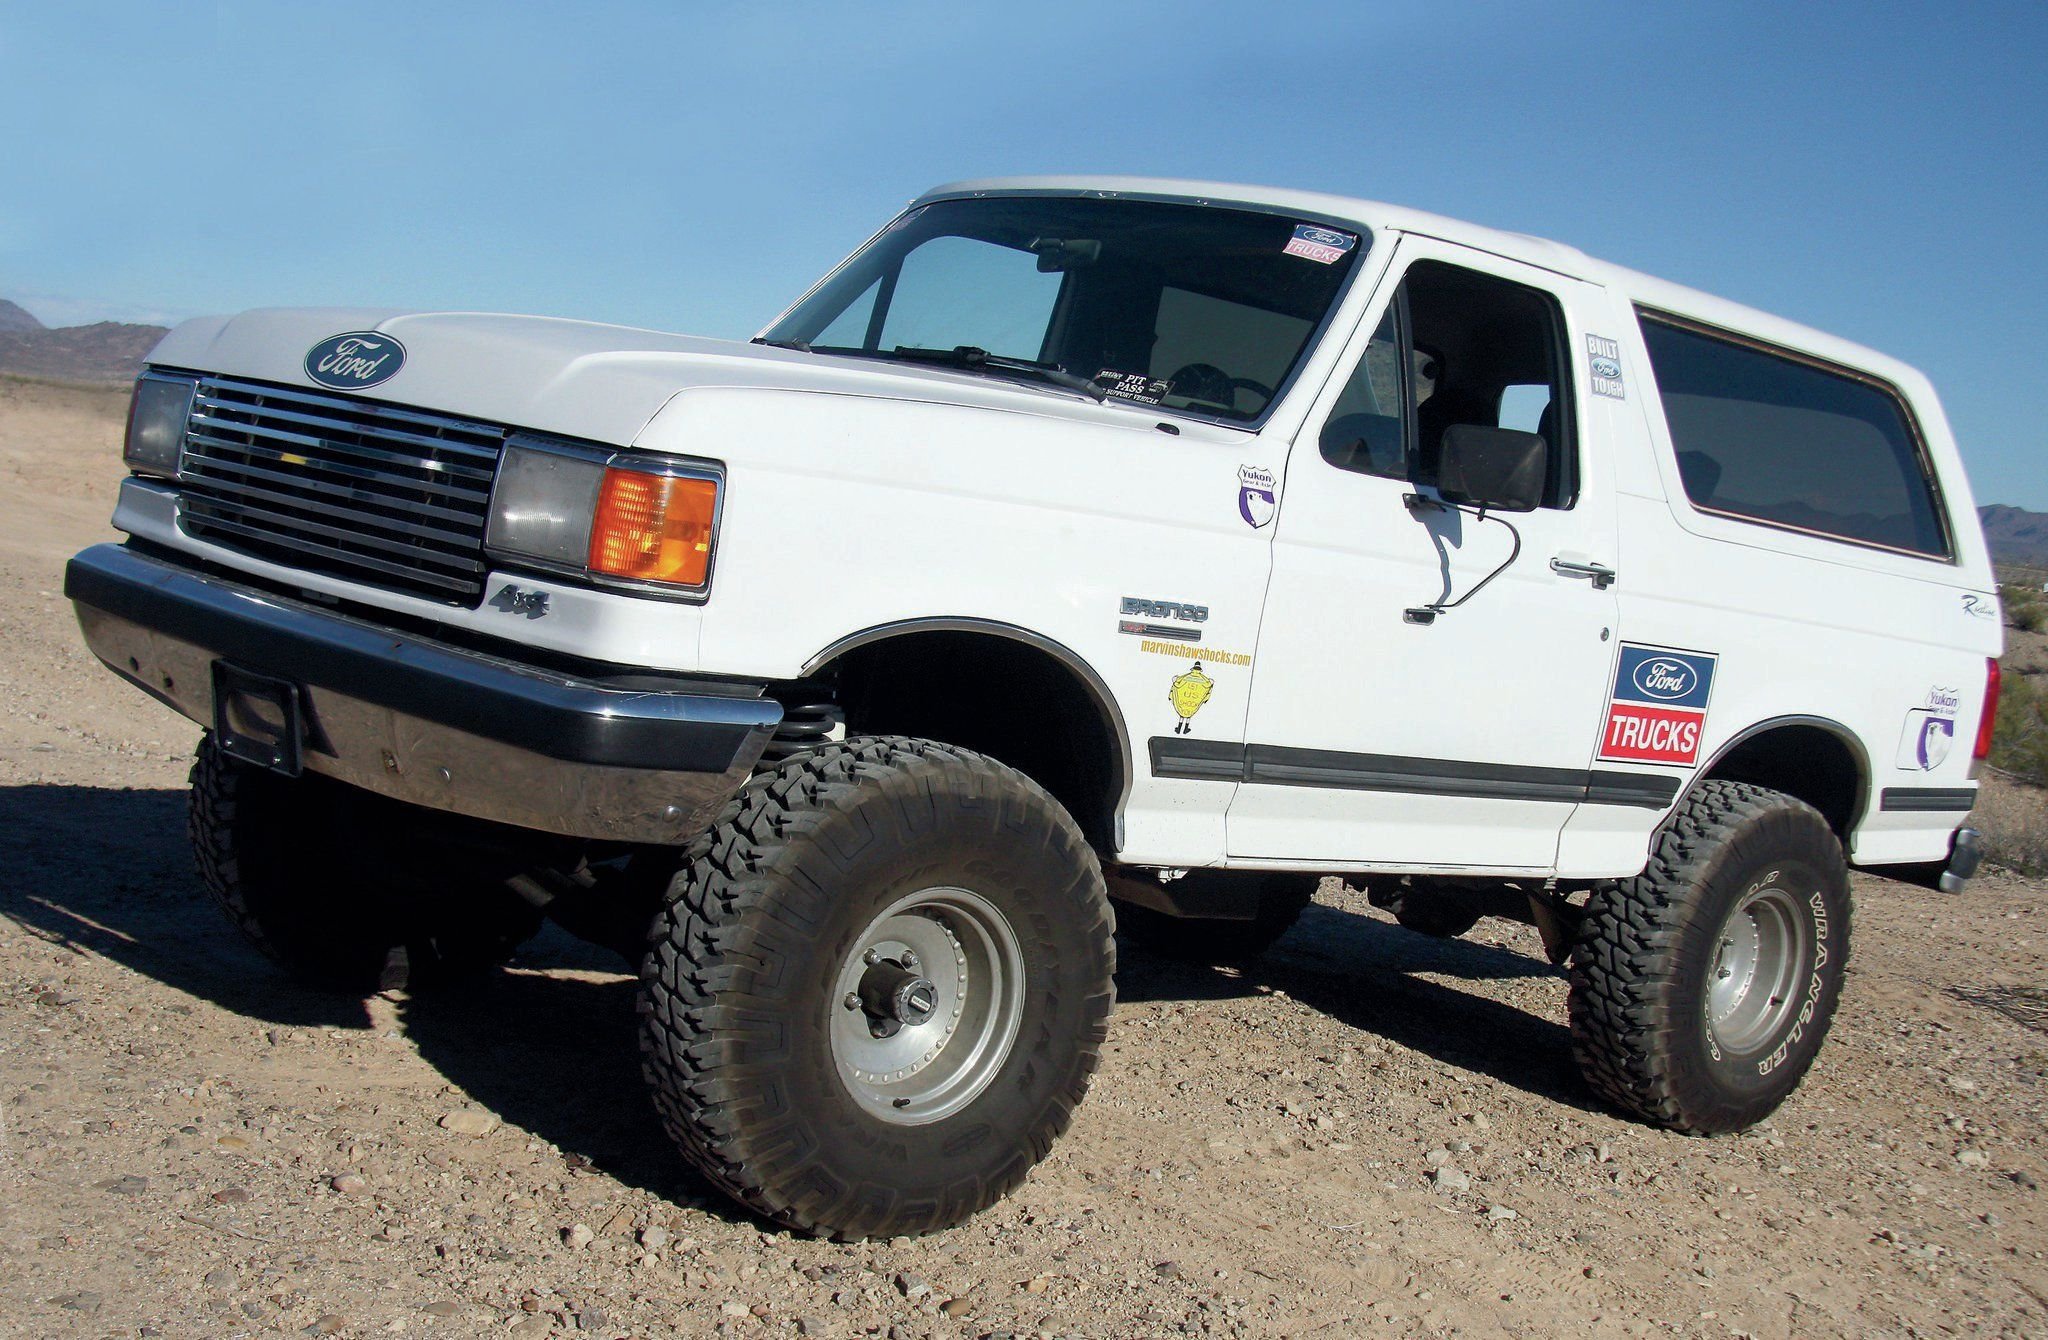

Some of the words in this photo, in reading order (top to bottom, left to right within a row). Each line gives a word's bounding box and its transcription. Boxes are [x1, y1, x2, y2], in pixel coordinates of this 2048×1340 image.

[1311, 231, 1337, 243] Ford
[1287, 242, 1340, 261] TRUCKS
[1587, 337, 1617, 360] BUILT
[317, 338, 390, 380] Ford
[1597, 361, 1616, 376] Ford
[1115, 381, 1145, 394] PASS
[1125, 374, 1147, 385] PIT
[1105, 388, 1133, 399] SUPPORT
[1133, 394, 1159, 405] VEHICLE
[1242, 469, 1272, 483] Yukon
[1119, 596, 1209, 623] BRONCO
[1140, 639, 1252, 667] marvinshawshocks.com
[1645, 662, 1686, 692] Ford
[1184, 690, 1199, 699] US
[1930, 691, 1958, 707] Yukon
[1610, 715, 1698, 753] TRUCKS
[1757, 891, 1829, 1076] WRANGLER
